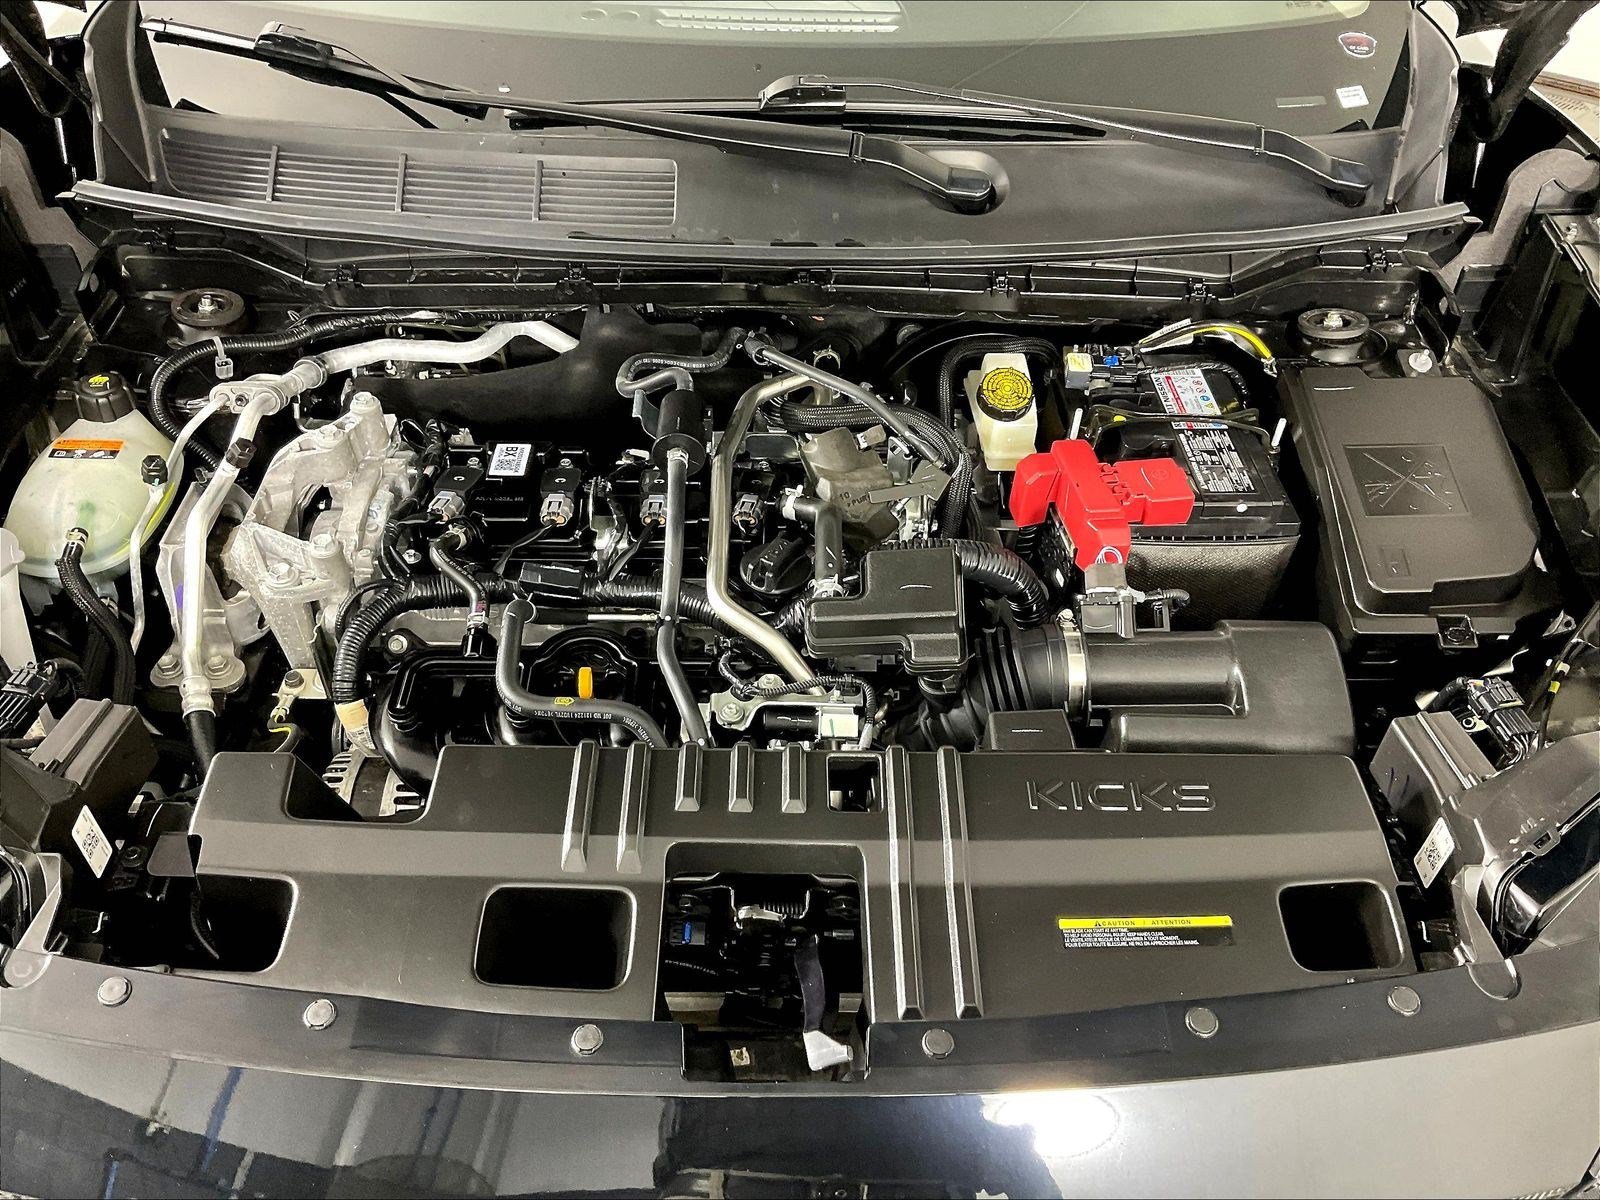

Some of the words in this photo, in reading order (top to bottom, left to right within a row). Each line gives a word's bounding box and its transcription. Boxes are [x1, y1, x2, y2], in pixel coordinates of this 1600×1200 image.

[1154, 376, 1171, 403] NISSAN
[504, 446, 518, 458] BX
[1025, 780, 1216, 812] KICKS
